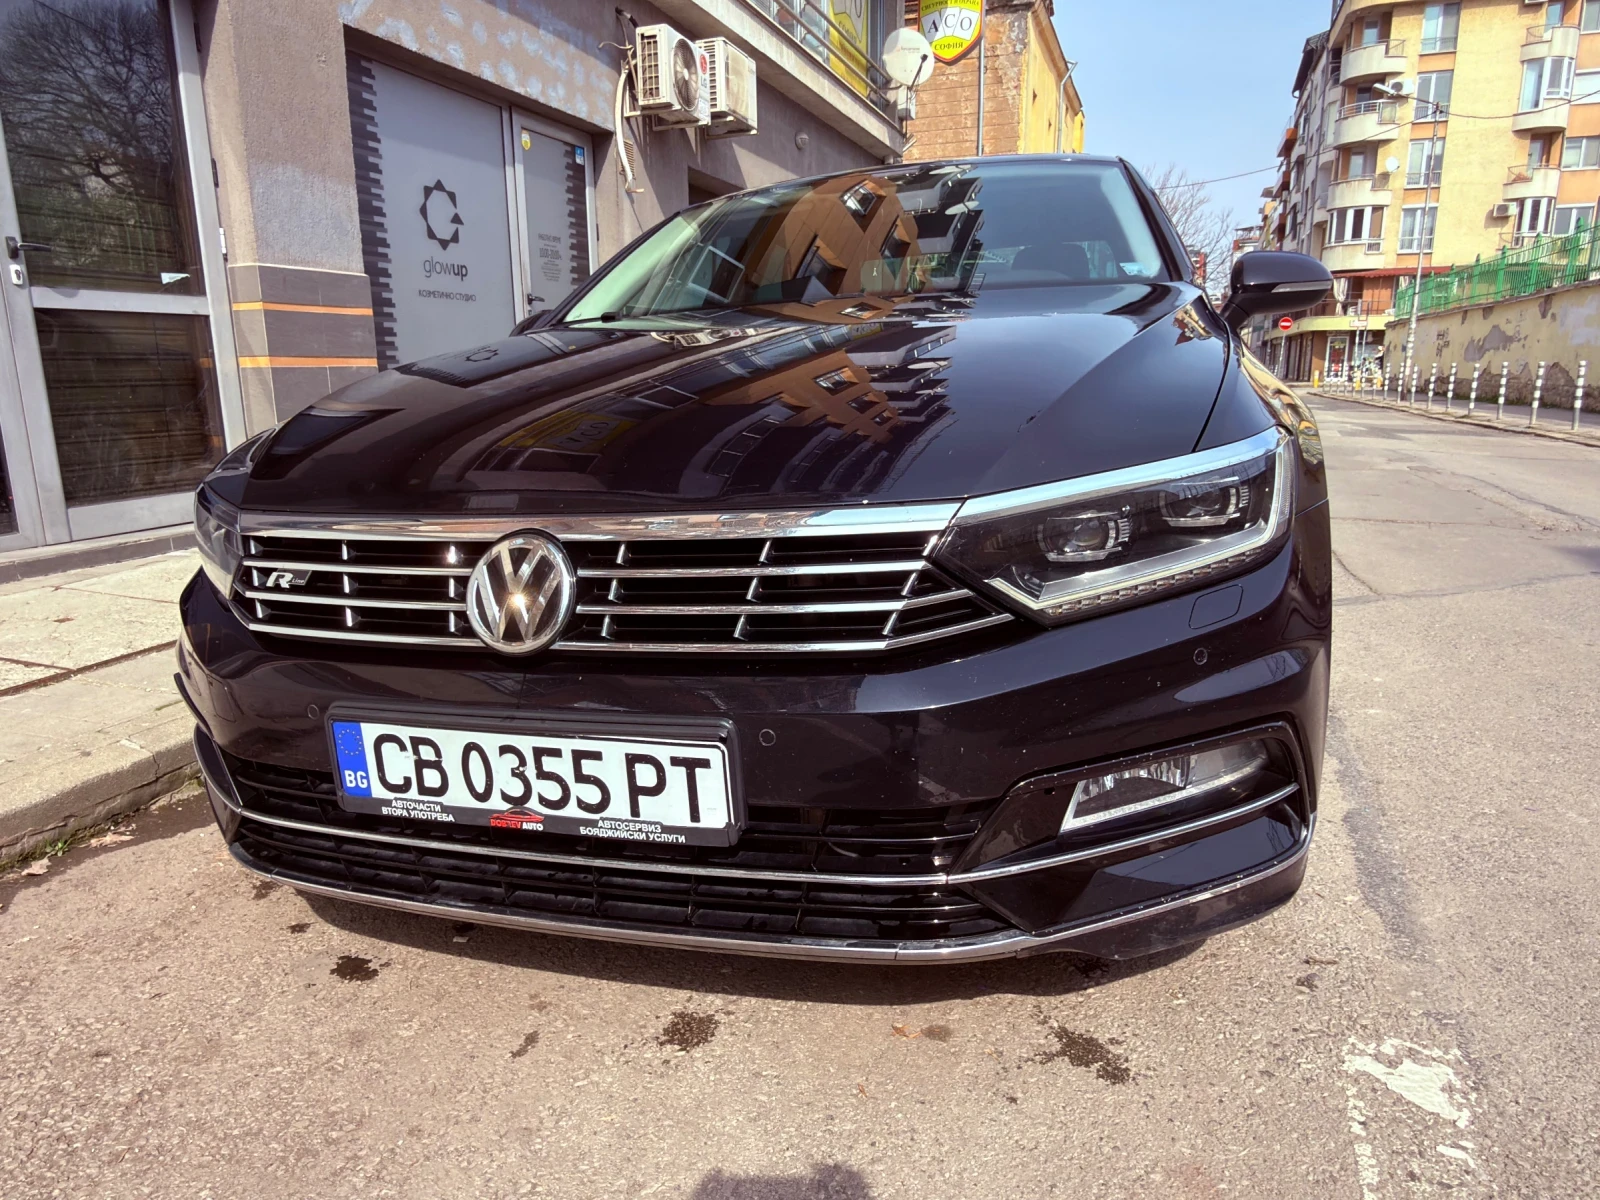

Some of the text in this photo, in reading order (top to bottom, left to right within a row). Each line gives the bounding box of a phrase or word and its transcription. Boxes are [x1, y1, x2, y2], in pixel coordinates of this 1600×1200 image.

[927, 13, 973, 33] АСО
[934, 42, 964, 50] СОФИЯ
[423, 256, 468, 281] glowup
[418, 289, 476, 302] КОЗМЕТИЧНО СТУДИО
[266, 571, 290, 588] R
[344, 770, 368, 788] BG
[373, 733, 711, 823] CB 0355 PT
[381, 806, 455, 822] ВТОРА УПОТРЕБА
[391, 799, 442, 813] АВТОЧАСТИ
[522, 822, 544, 831] AUTO
[597, 820, 662, 833] АВТОСЕРВИЗ
[579, 826, 686, 844] БОЯДЖИЙСКИ УСЛУГИ
